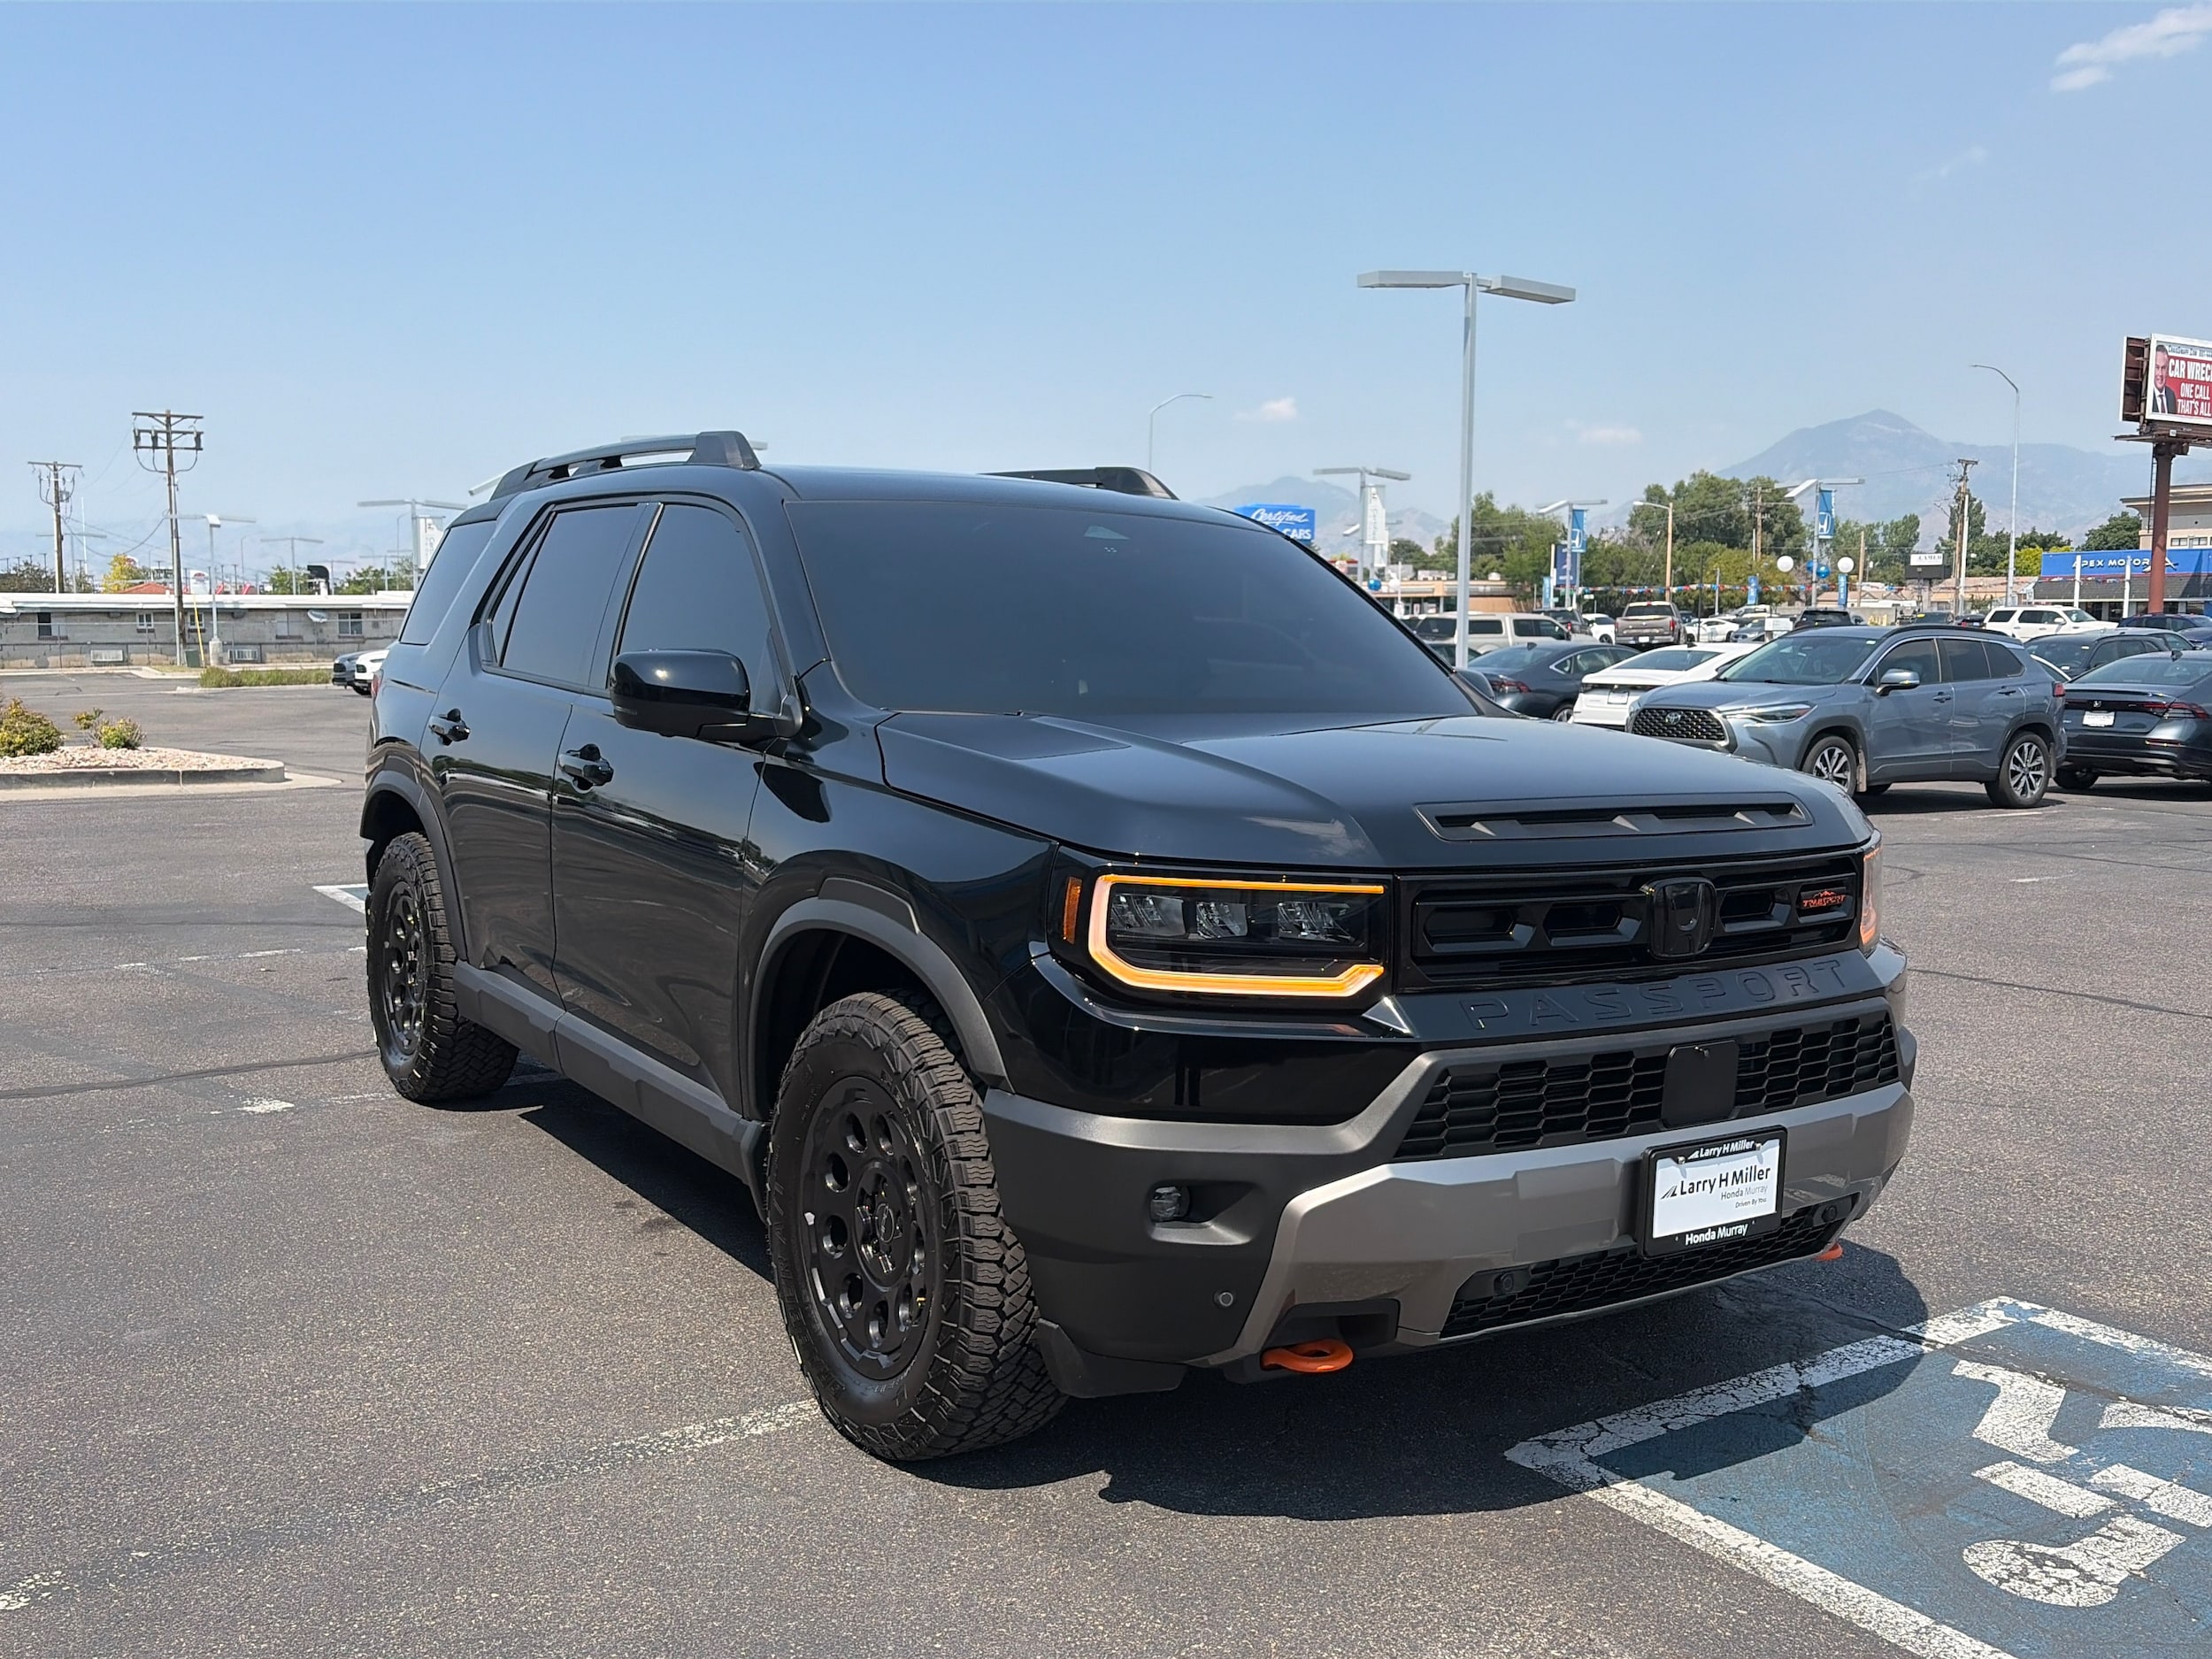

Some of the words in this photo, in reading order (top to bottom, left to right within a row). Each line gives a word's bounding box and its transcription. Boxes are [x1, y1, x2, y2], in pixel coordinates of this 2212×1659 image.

[2169, 358, 2185, 379] CAR
[2187, 361, 2212, 382] WREC
[2180, 382, 2194, 398] ONE
[2195, 384, 2210, 400] CALL
[2177, 399, 2200, 415] THAT'S
[2200, 402, 2211, 417] ALL
[1250, 509, 1309, 526] Certified
[2108, 557, 2151, 567] MOOR
[1458, 959, 1846, 1030] PASSPORT
[1700, 1147, 1723, 1158] Larry
[1724, 1144, 1731, 1154] H
[1732, 1139, 1755, 1151] Miller
[1680, 1178, 1717, 1195] Larry
[1719, 1172, 1729, 1188] H
[1731, 1164, 1770, 1186] Miller
[1721, 1187, 1743, 1201] Honda
[1744, 1186, 1768, 1196] Murray
[1735, 1200, 1751, 1209] Driven
[1685, 1230, 1717, 1246] Honda
[1717, 1223, 1748, 1240] Murray
